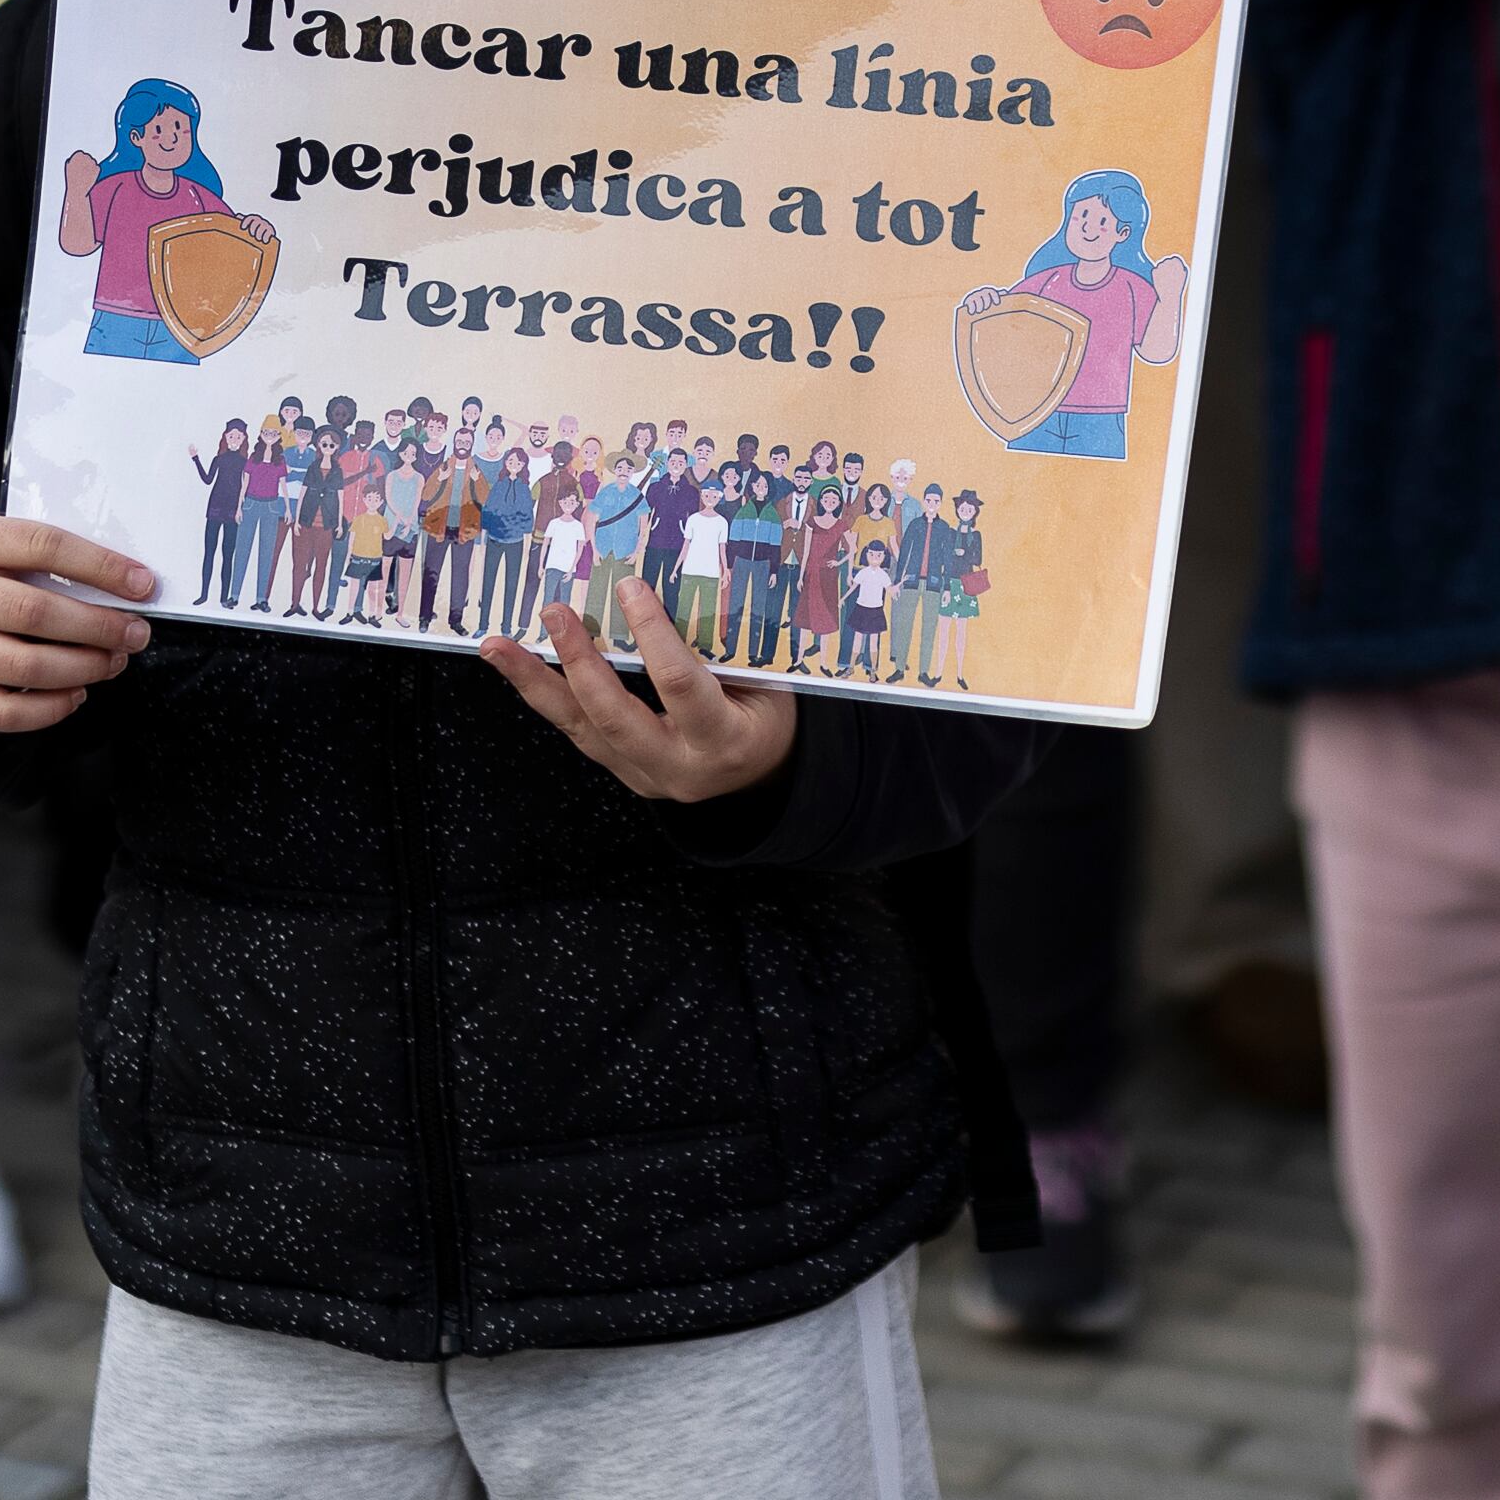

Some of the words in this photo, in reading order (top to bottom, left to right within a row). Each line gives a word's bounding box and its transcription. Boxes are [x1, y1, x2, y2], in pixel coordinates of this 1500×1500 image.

[614, 41, 802, 103] una
[826, 41, 1054, 126] línia
[271, 134, 745, 227] perjudica
[769, 187, 826, 235] a
[853, 181, 985, 251] tot
[343, 258, 885, 373] Terrassa!!
